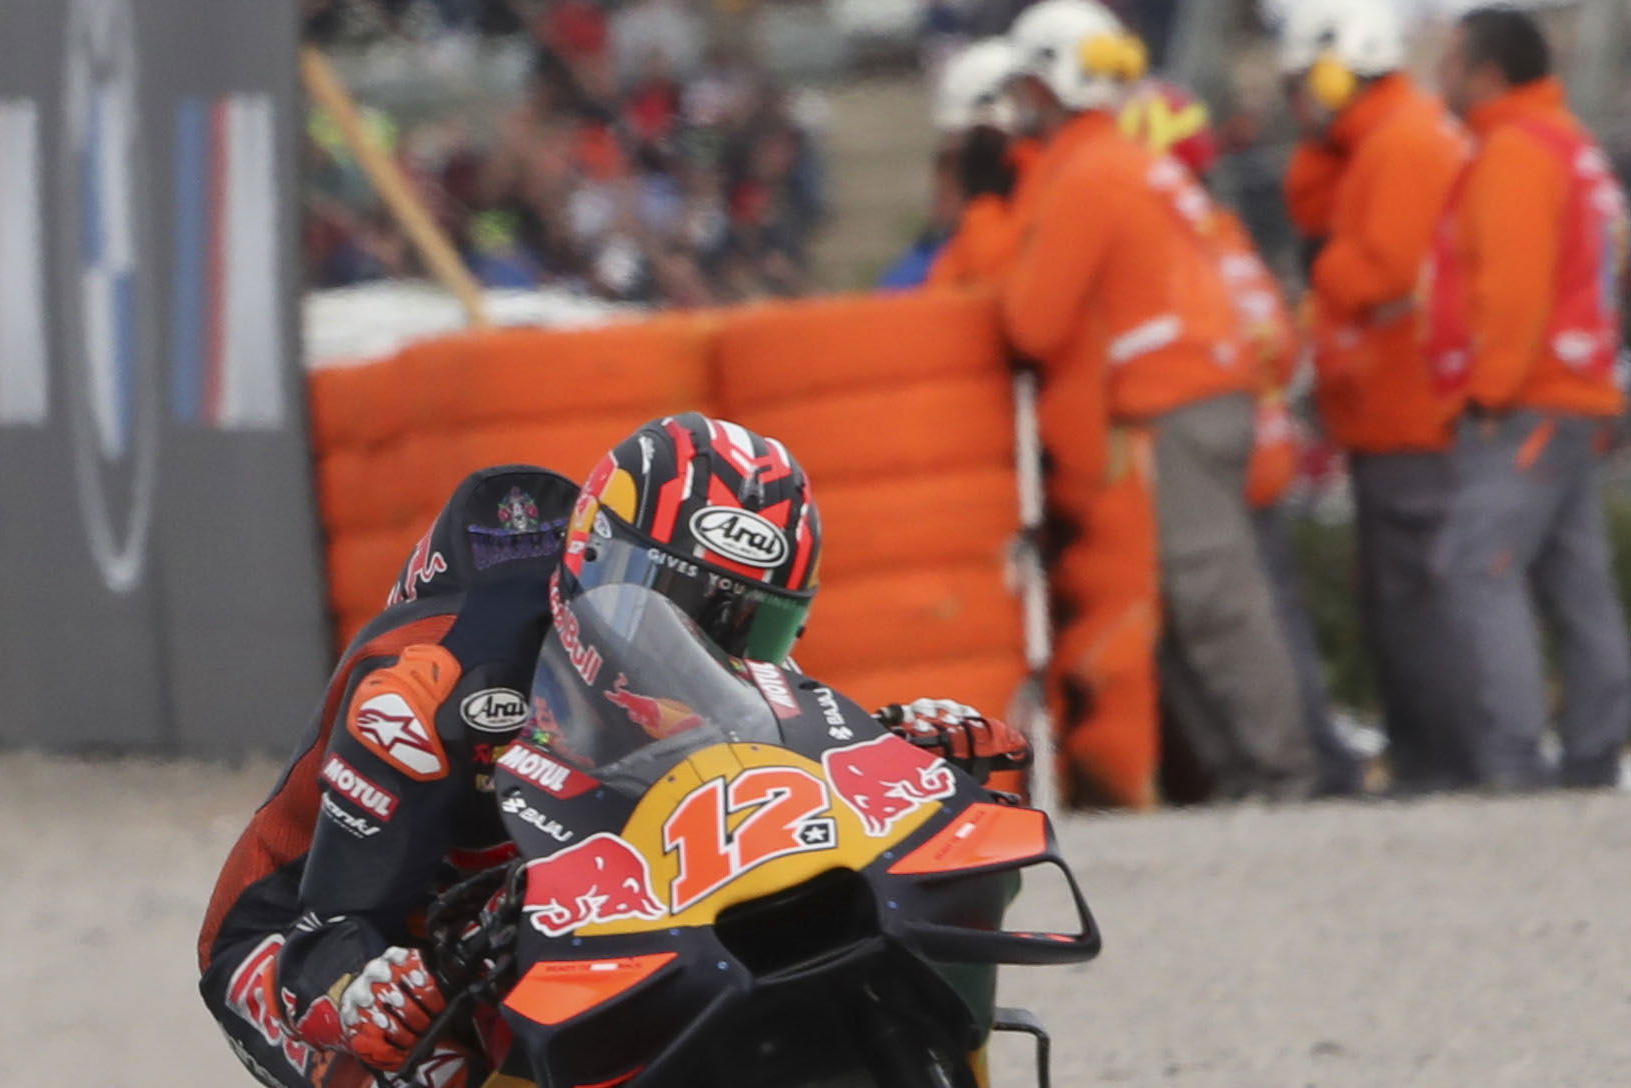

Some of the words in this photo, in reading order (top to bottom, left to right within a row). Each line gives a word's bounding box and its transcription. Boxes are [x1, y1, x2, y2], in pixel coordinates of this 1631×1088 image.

[699, 515, 779, 557] Arai
[647, 547, 699, 578] GIVES
[708, 571, 746, 596] YOU
[470, 696, 525, 719] Arai
[812, 686, 846, 726] BAJAJ
[322, 757, 393, 817] MOTUL
[497, 744, 571, 792] MOTUL
[519, 805, 575, 842] BAJAJ
[662, 765, 834, 915] 12
